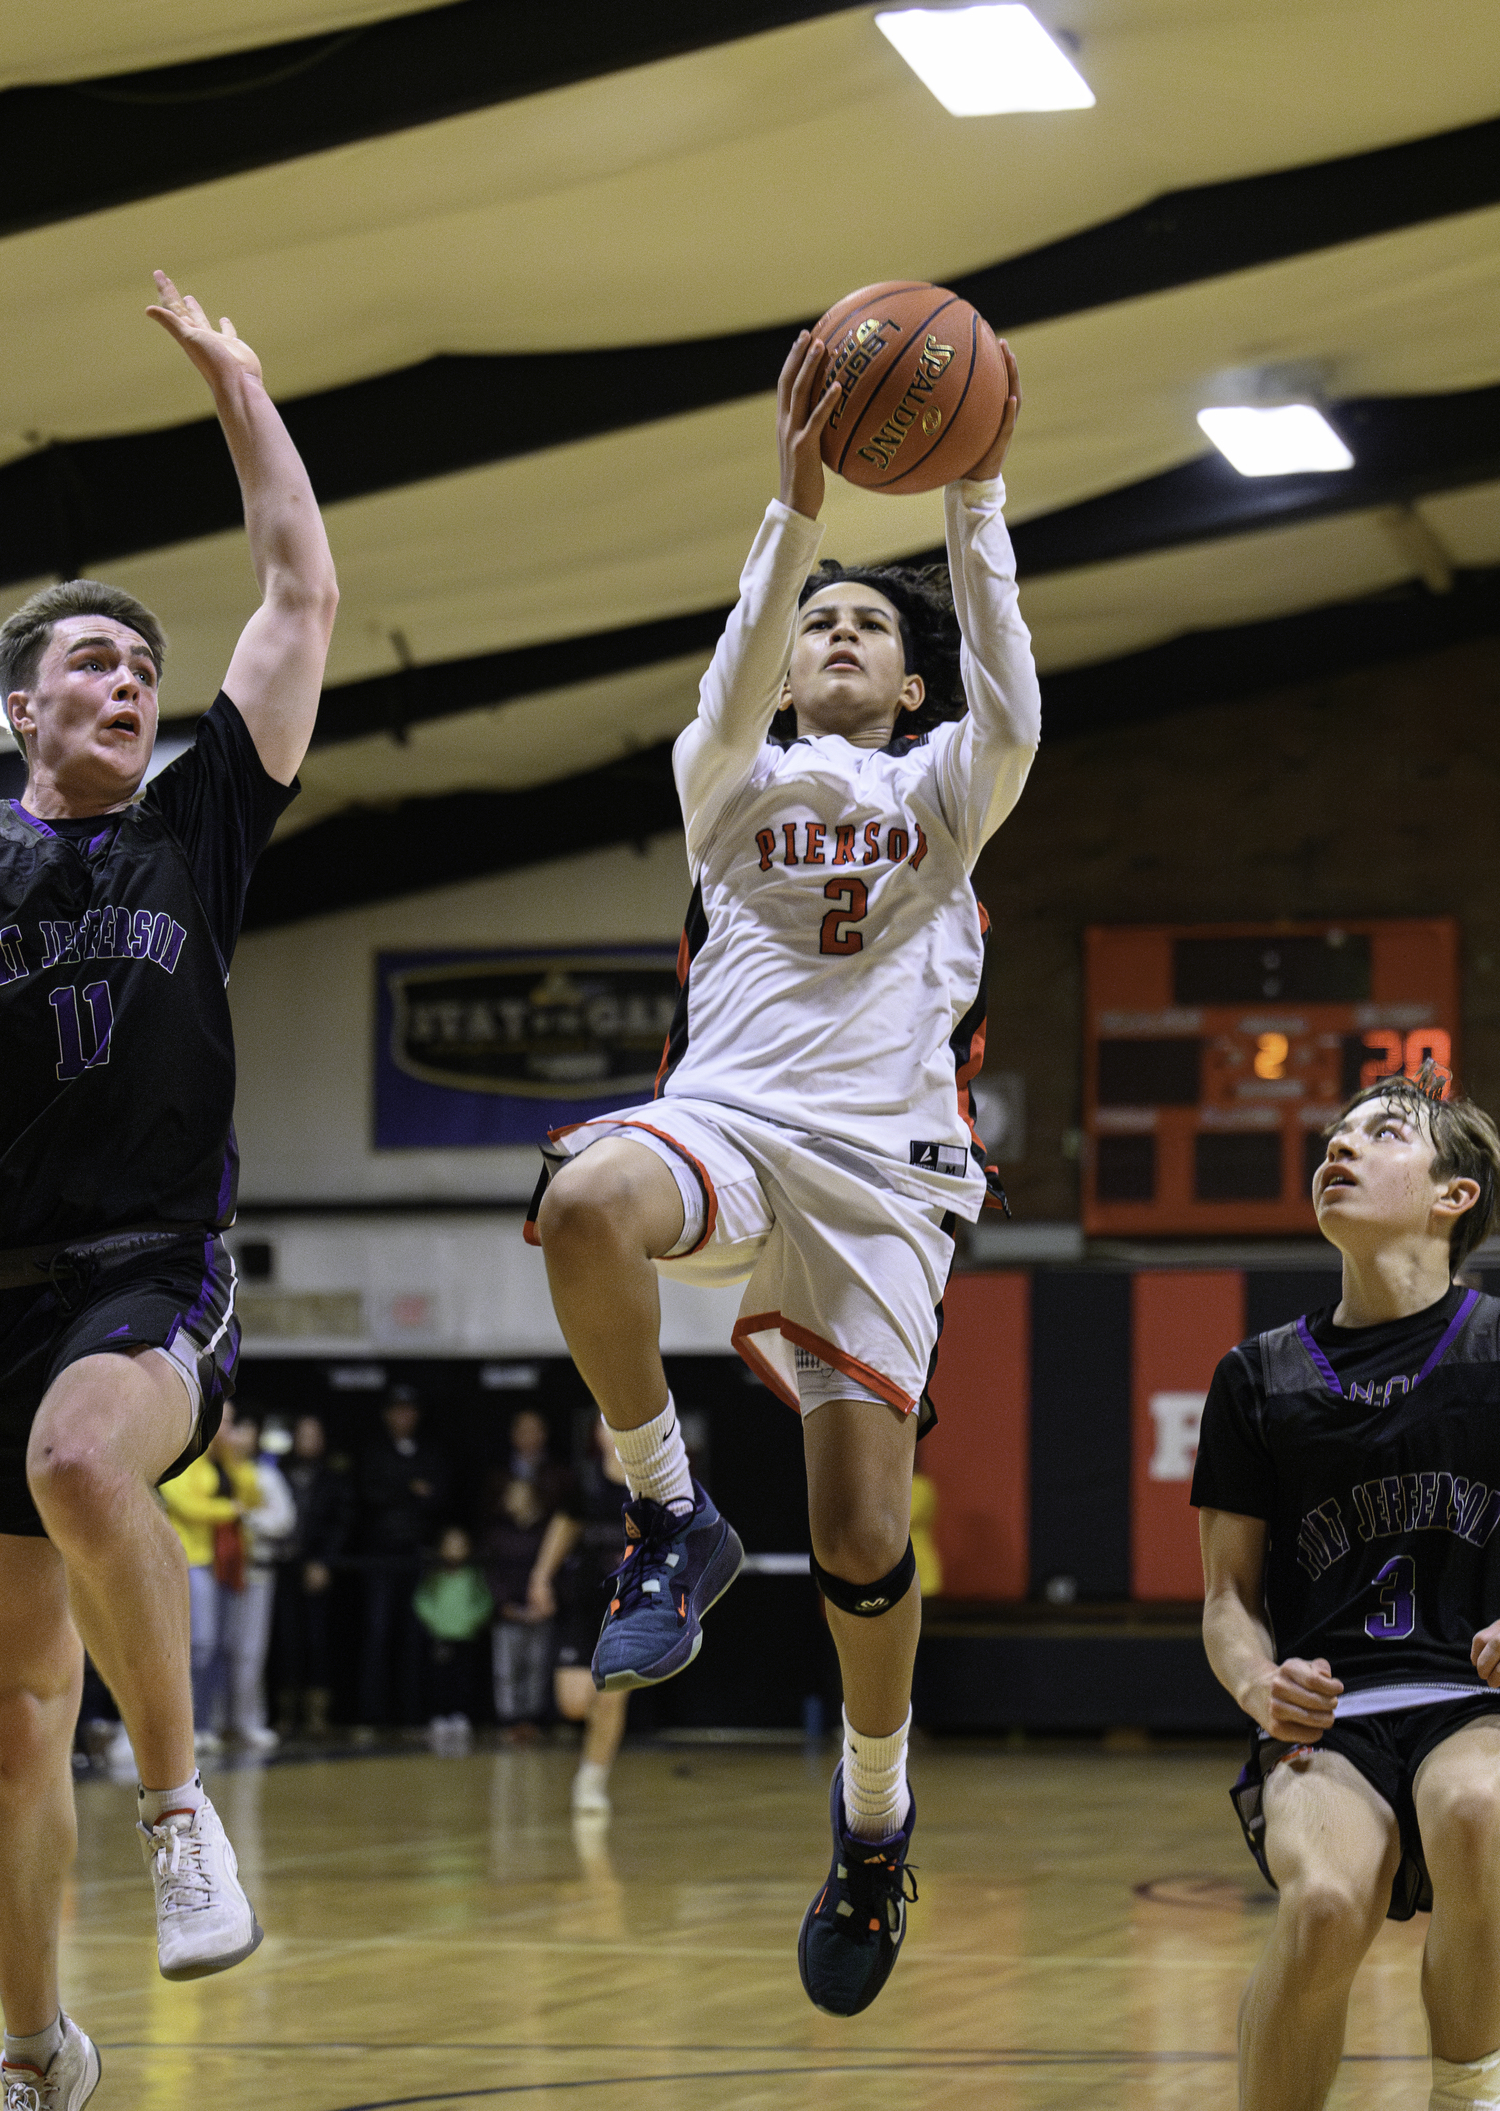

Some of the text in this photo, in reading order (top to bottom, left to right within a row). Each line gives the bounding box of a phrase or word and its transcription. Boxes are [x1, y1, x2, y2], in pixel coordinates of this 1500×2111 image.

[857, 333, 956, 471] SPALDING
[39, 904, 188, 974] JEFFERSON
[819, 877, 869, 956] 2
[49, 980, 114, 1081] 11
[1364, 1555, 1416, 1640] 3
